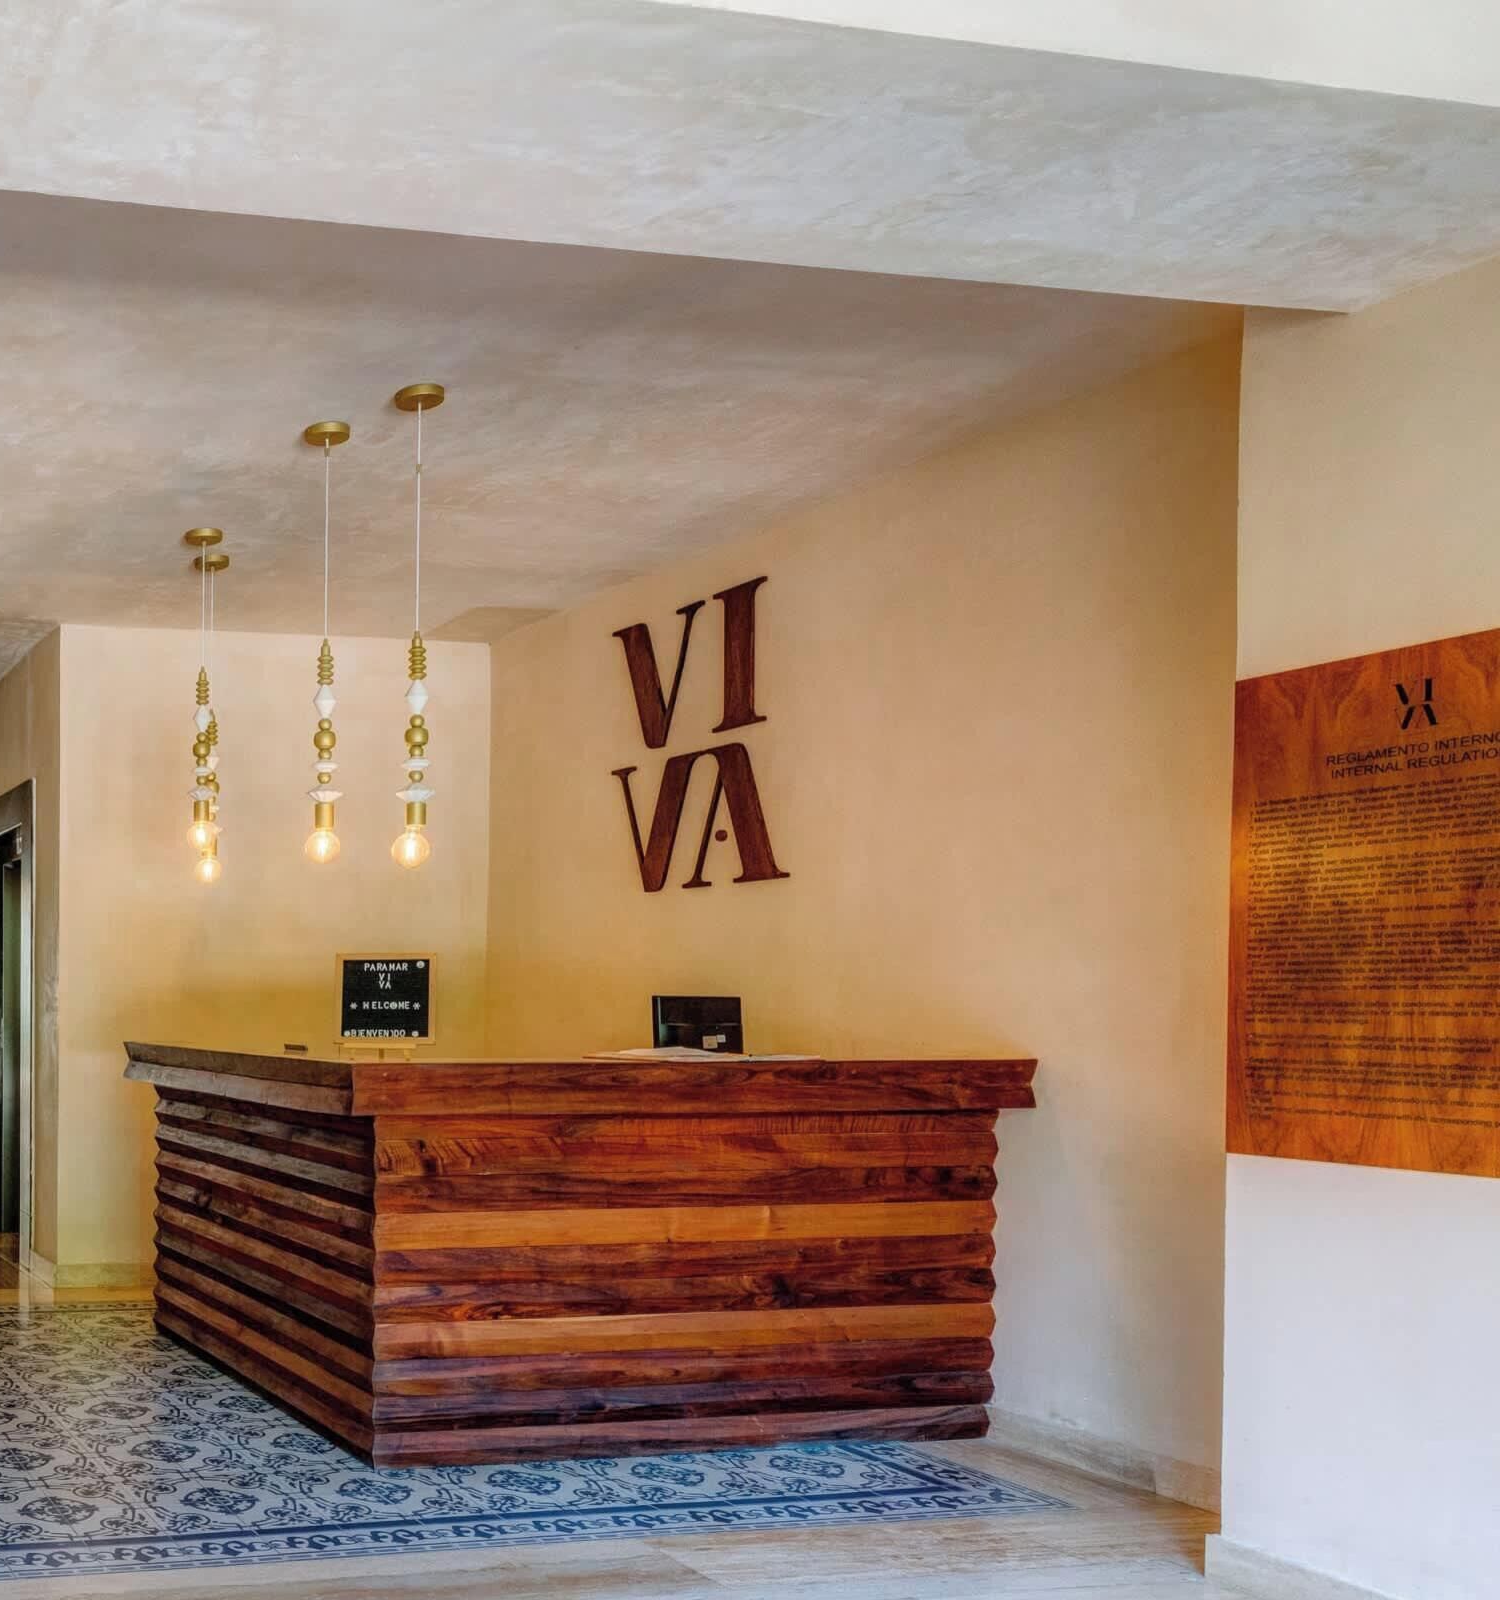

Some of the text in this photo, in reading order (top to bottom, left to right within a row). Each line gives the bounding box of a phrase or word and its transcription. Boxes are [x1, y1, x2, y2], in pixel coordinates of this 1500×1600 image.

[612, 576, 768, 749] VI
[1326, 743, 1429, 766] REGLAMENTO
[1331, 747, 1500, 779] INTERNAL REGULATIO
[611, 743, 790, 892] VA
